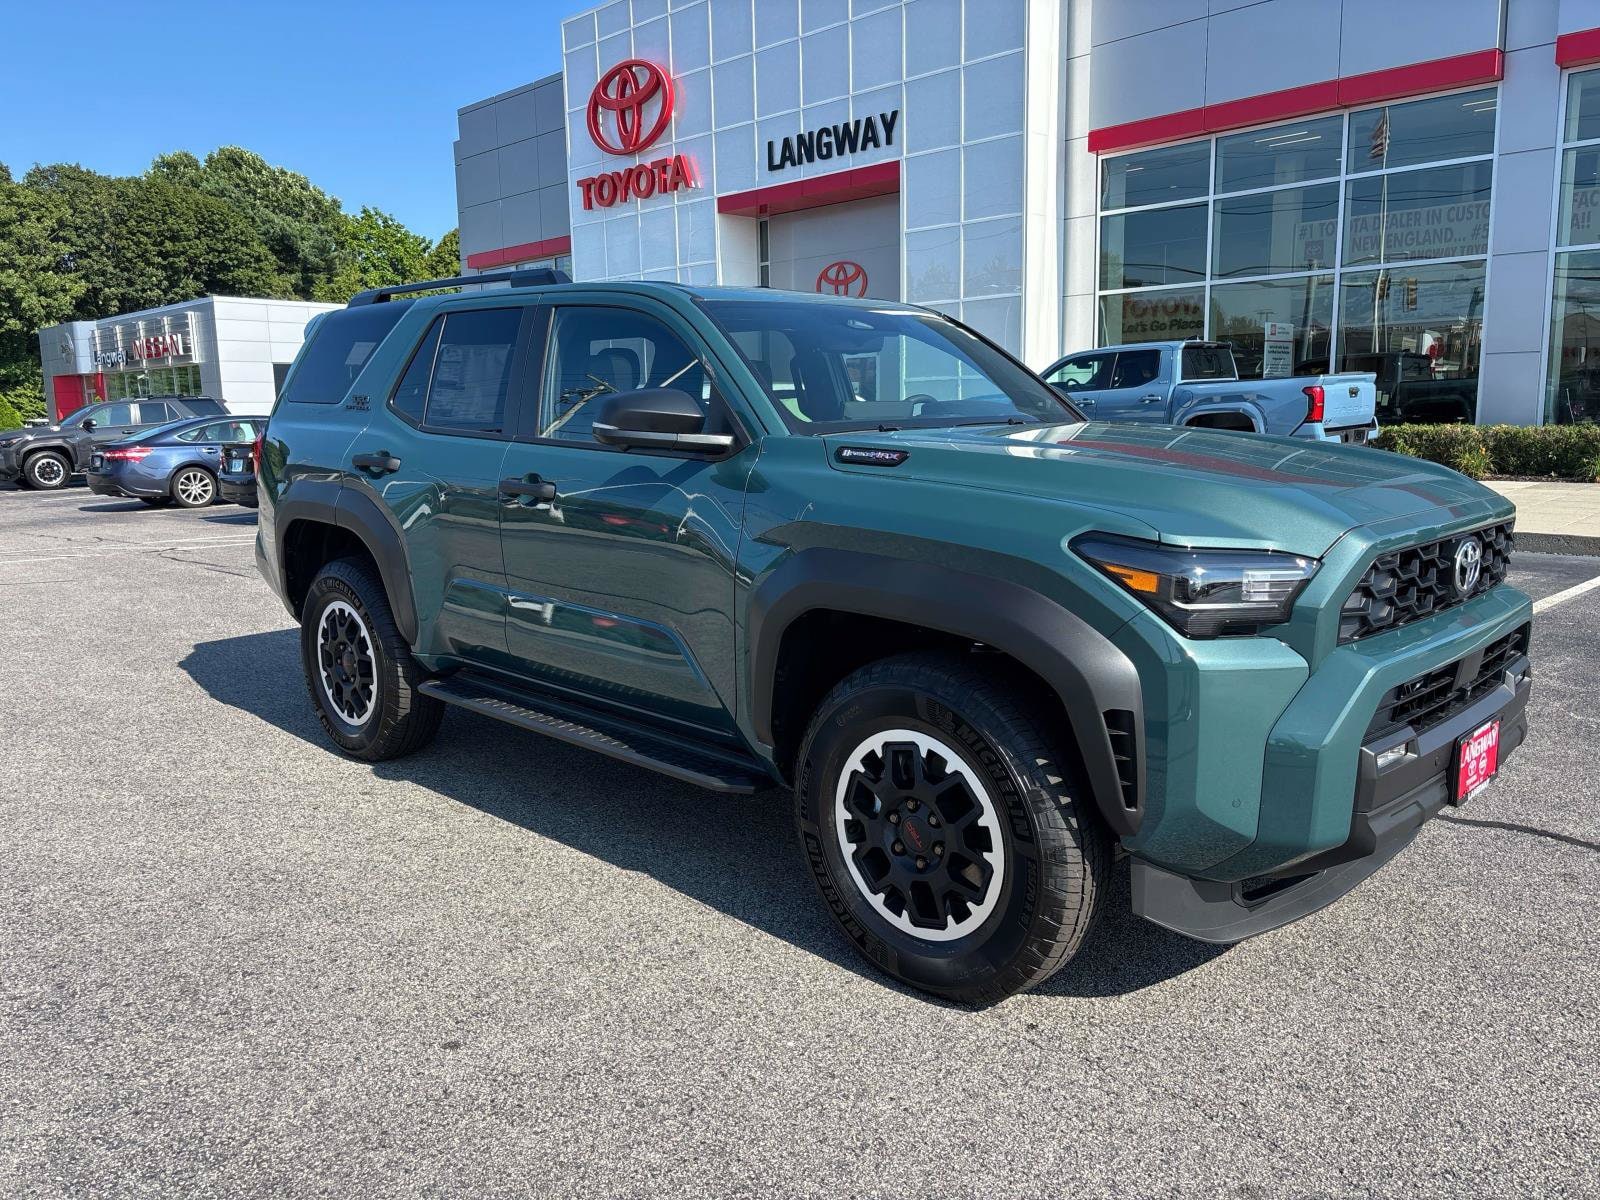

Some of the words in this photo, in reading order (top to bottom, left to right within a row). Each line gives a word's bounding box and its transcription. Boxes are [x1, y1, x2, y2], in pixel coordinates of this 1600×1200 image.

[766, 109, 899, 172] LANGWAY
[576, 154, 695, 211] TOYOTA
[1299, 225, 1313, 240] #1
[1320, 217, 1368, 237] TOTA
[1372, 210, 1421, 230] DEALER
[1426, 208, 1442, 225] IN
[1351, 234, 1380, 252] NEW
[1150, 319, 1167, 332] Go
[94, 349, 129, 368] Langway
[133, 333, 184, 360] NISSAN
[1460, 727, 1498, 768] LANGWAY
[956, 720, 1029, 838] MICHELIN
[804, 835, 864, 942] MICHELIN
